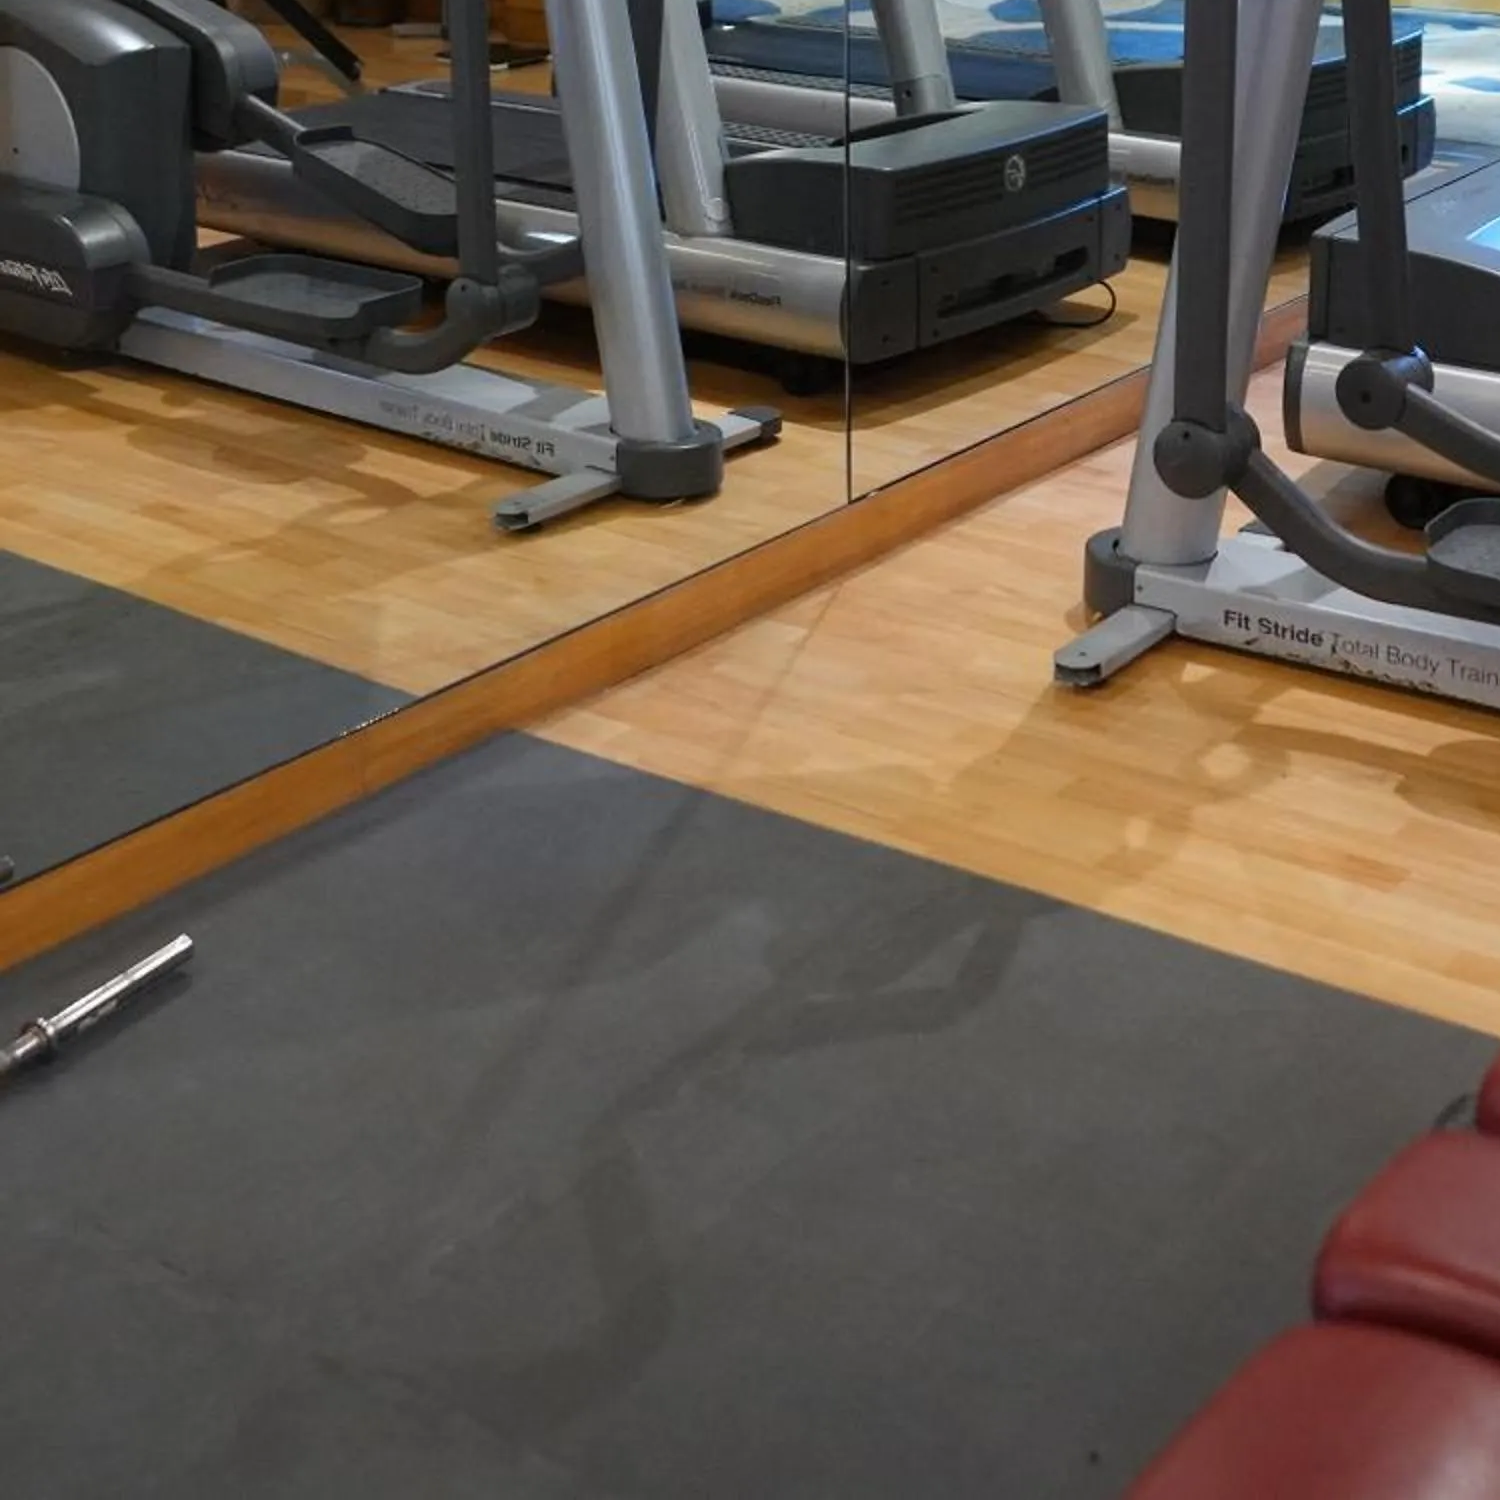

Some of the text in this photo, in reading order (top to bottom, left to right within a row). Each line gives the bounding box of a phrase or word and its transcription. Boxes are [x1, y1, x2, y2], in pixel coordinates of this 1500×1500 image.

[1223, 609, 1250, 631] Fit
[1257, 616, 1324, 648] Stride
[1328, 631, 1379, 660] Total
[1386, 644, 1440, 677] Body
